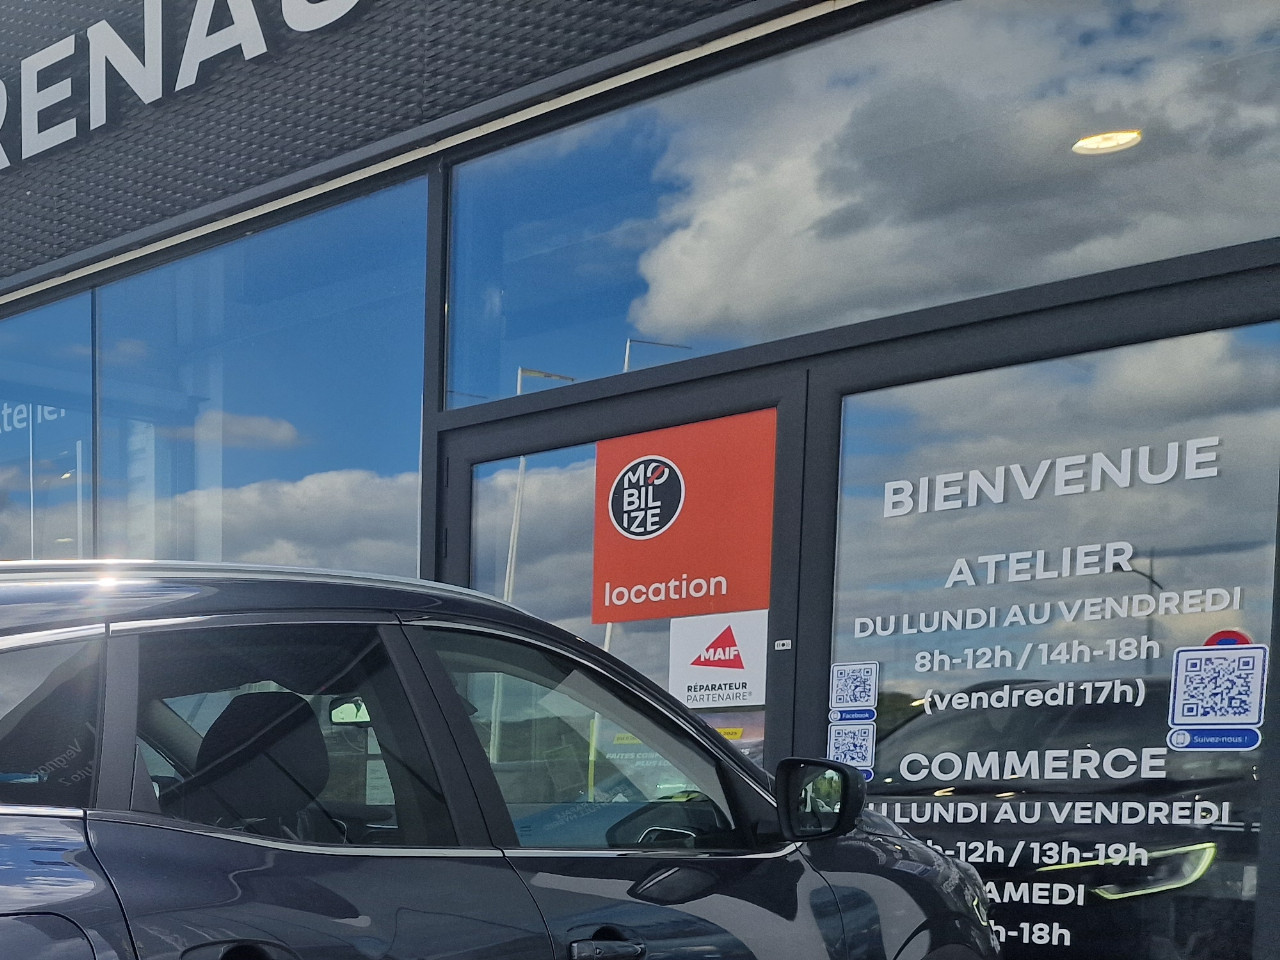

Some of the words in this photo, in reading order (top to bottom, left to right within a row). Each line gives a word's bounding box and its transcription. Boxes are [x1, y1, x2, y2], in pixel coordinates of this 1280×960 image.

[883, 436, 1221, 518] BIENVENUE
[944, 541, 1134, 588] ATELIER
[604, 573, 728, 607] location
[854, 615, 896, 638] DU
[901, 606, 997, 633] LUNDI
[1003, 602, 1052, 627] AU
[1057, 586, 1242, 623] VENDREDI
[700, 646, 739, 662] MAIF
[914, 648, 1013, 673] 8h-12h
[1037, 635, 1160, 666] 14h-18h
[687, 682, 747, 693] RÉPARATEUR
[923, 684, 1075, 715] (vendredi
[1080, 678, 1147, 707] 17h)
[841, 712, 870, 720] Facebook
[1193, 735, 1242, 744] Suivez-nous
[899, 747, 1168, 782] COMMERCE
[894, 802, 988, 824] LUNDI
[993, 801, 1042, 824] AU
[1048, 801, 1230, 825] VENDREDI
[926, 840, 1005, 863] h-12h
[1029, 841, 1149, 867] 13h-19h
[985, 881, 1085, 906] AMEDI
[990, 920, 1071, 947] h-18h
